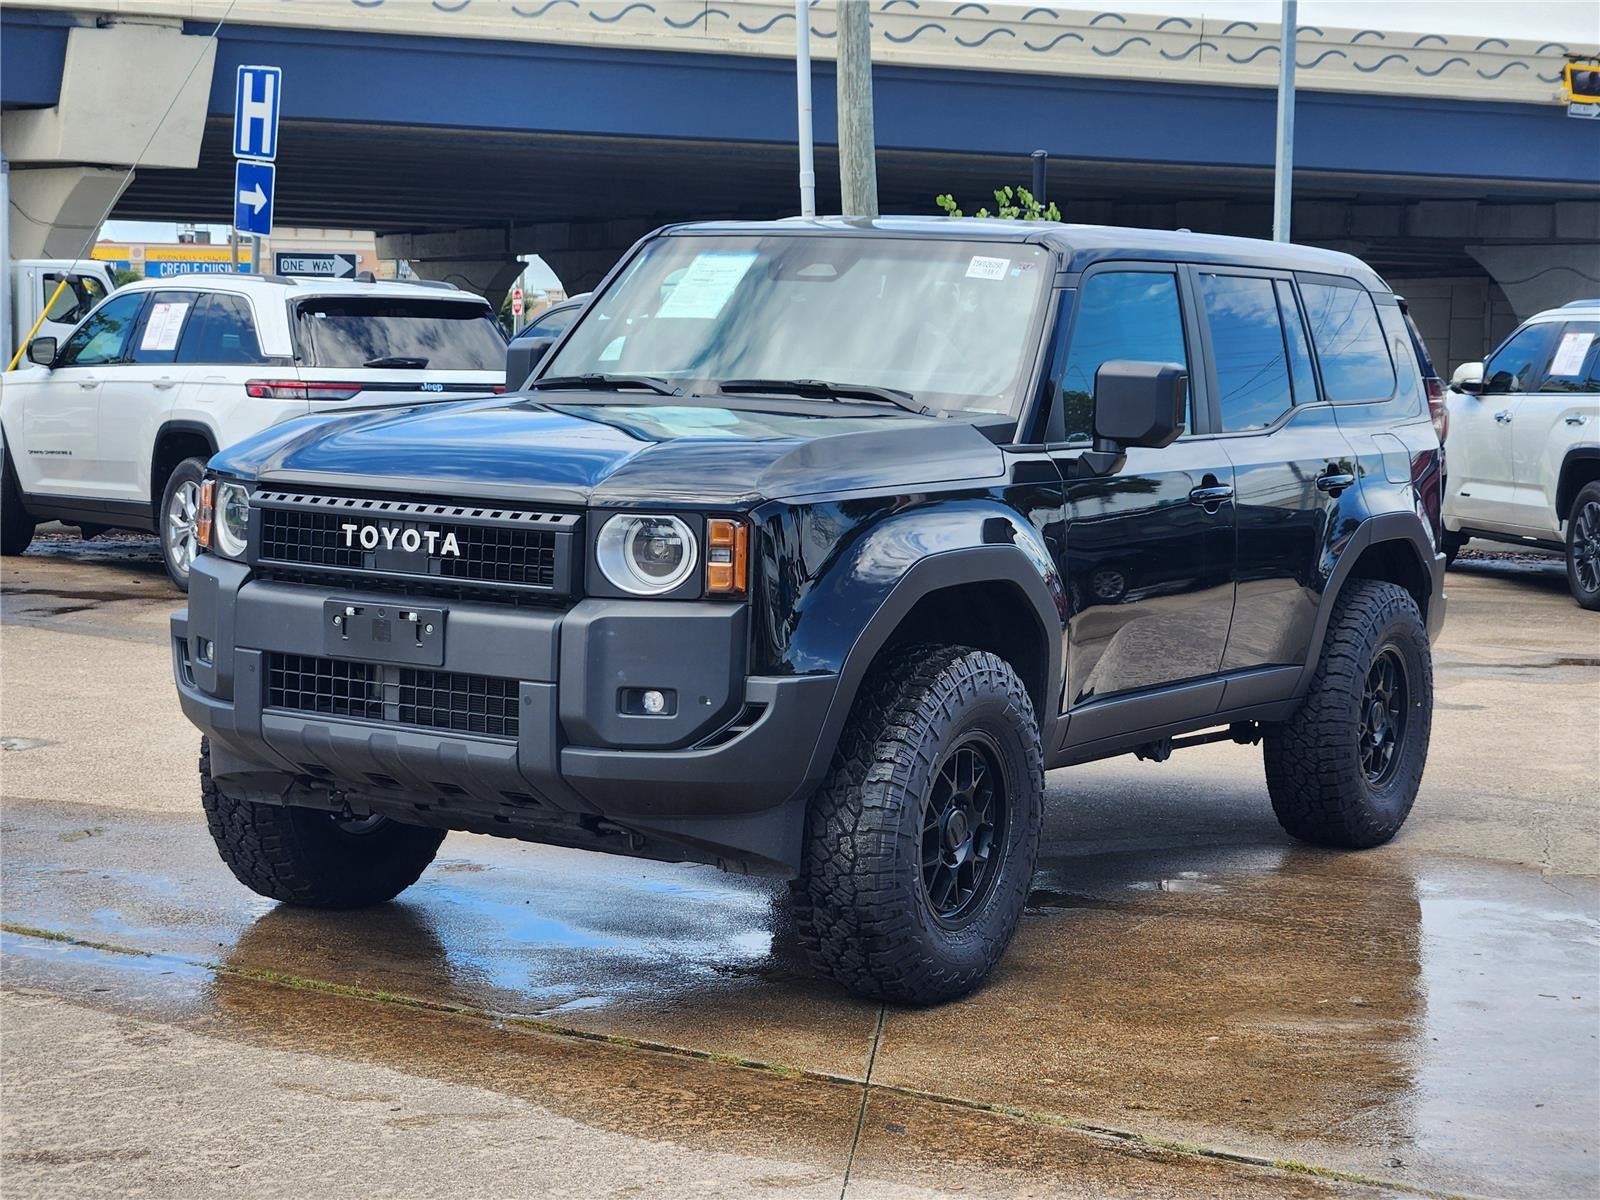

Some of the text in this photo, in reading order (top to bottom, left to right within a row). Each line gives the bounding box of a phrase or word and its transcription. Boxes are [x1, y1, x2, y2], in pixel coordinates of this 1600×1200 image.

[240, 72, 275, 153] H
[282, 260, 335, 271] ONE WAY
[421, 382, 443, 392] Jeep
[341, 523, 461, 556] TOYOTA
